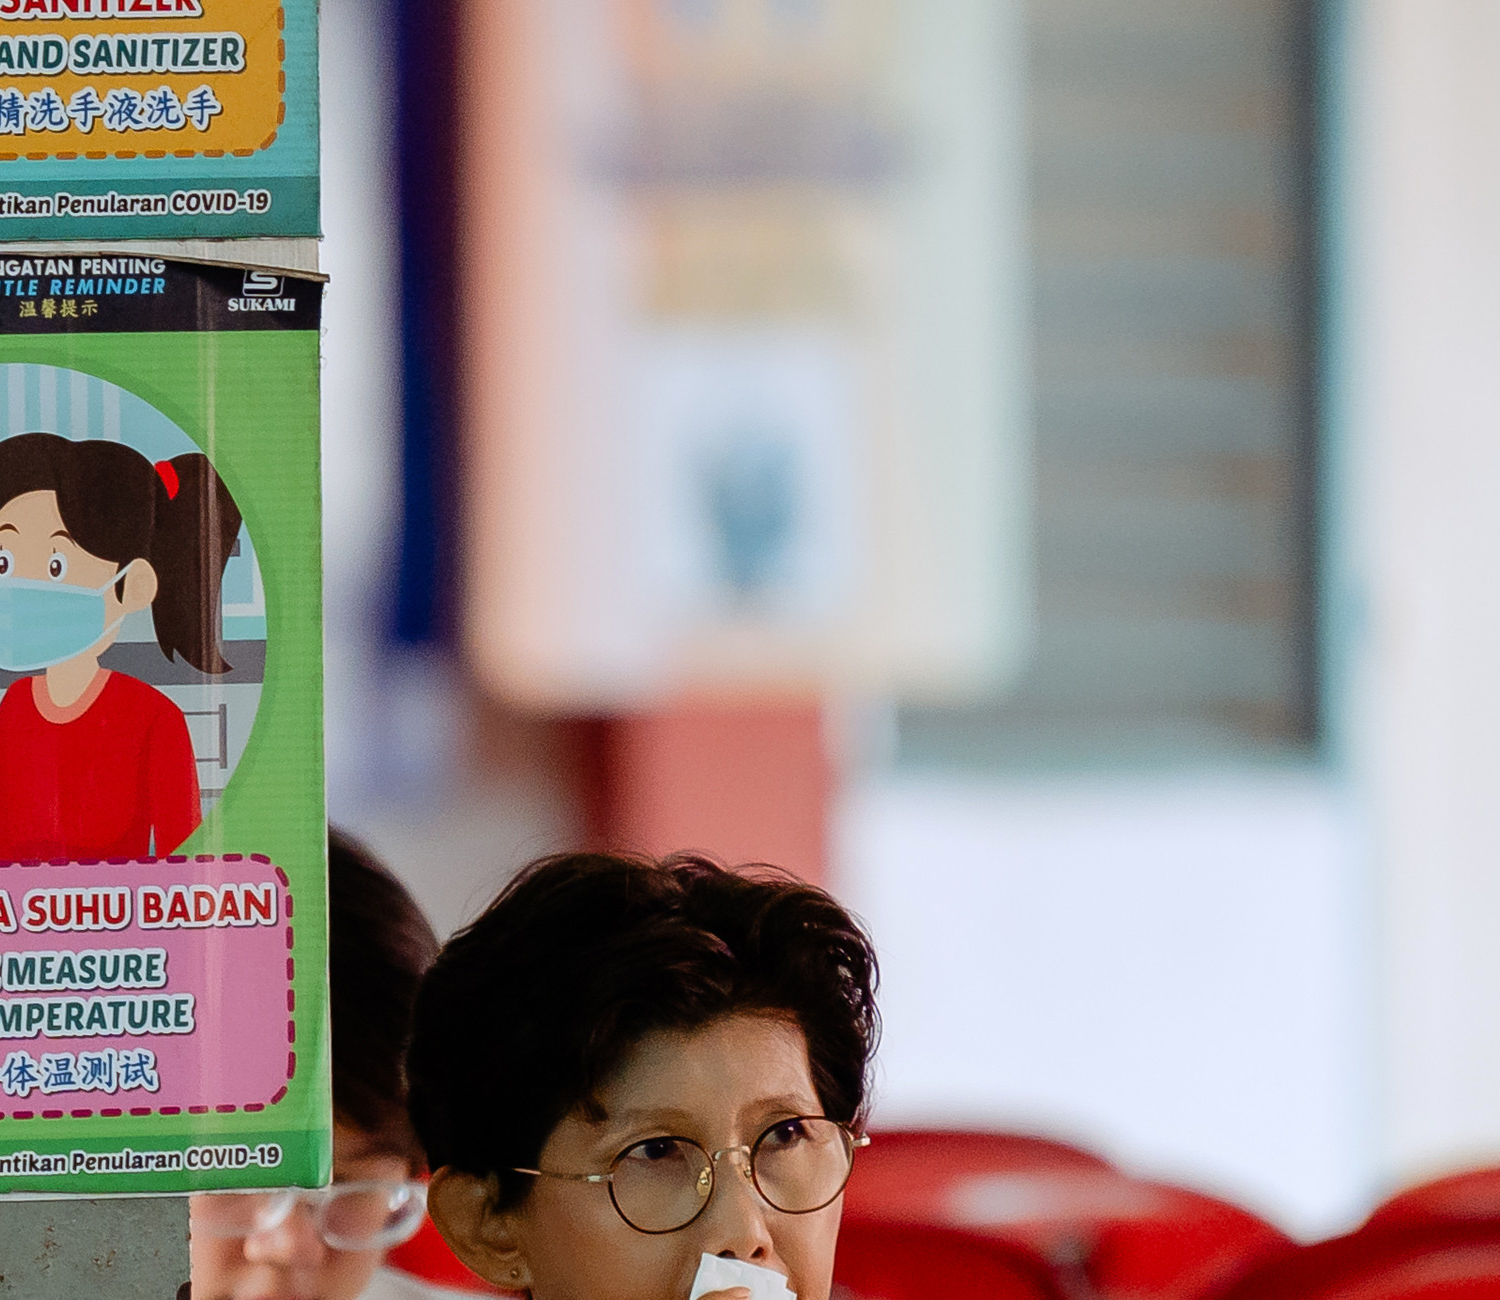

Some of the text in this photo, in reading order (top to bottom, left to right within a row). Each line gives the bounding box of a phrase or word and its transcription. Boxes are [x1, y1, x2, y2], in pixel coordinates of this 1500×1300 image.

[73, 37, 240, 69] SANITIZER
[57, 192, 167, 214] Penularan
[172, 192, 269, 211] COVID-19
[80, 258, 165, 275] PENTING
[50, 277, 165, 296] REMINDER
[228, 298, 296, 312] SUKAMI
[26, 893, 126, 926] SUHU
[143, 889, 271, 923] BADAN
[7, 953, 161, 985] MEASURE
[72, 1150, 181, 1172] Penularan
[186, 1146, 280, 1168] COVID-19
